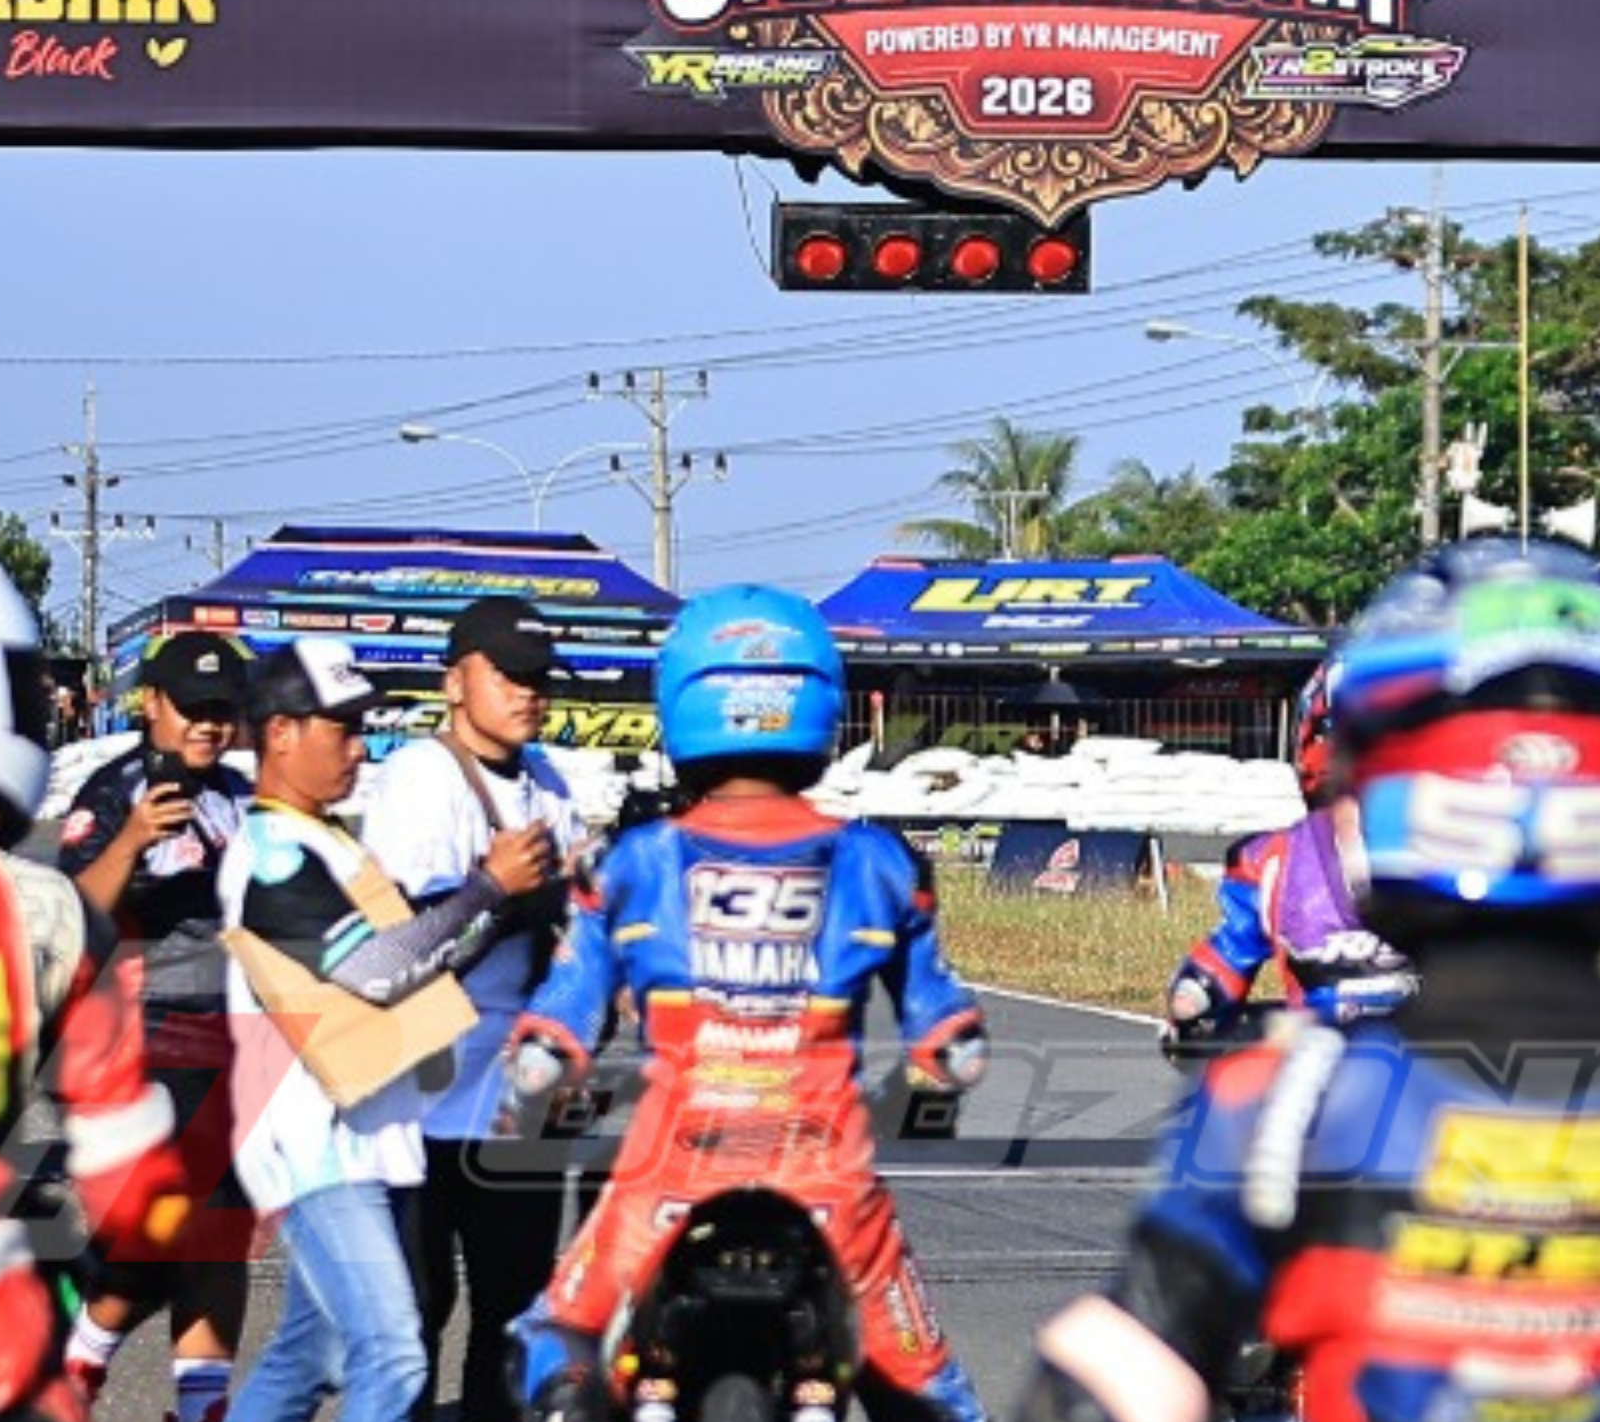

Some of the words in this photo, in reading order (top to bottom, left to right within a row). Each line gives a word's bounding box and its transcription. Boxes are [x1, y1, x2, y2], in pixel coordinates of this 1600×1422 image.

[4, 30, 120, 79] Black
[865, 25, 976, 55] POWERED
[984, 23, 1013, 48] BY
[1022, 24, 1052, 48] YR
[1057, 24, 1224, 59] MANAGEMENT
[646, 53, 718, 92] YR
[981, 78, 1093, 116] 2026
[690, 869, 824, 932] 135
